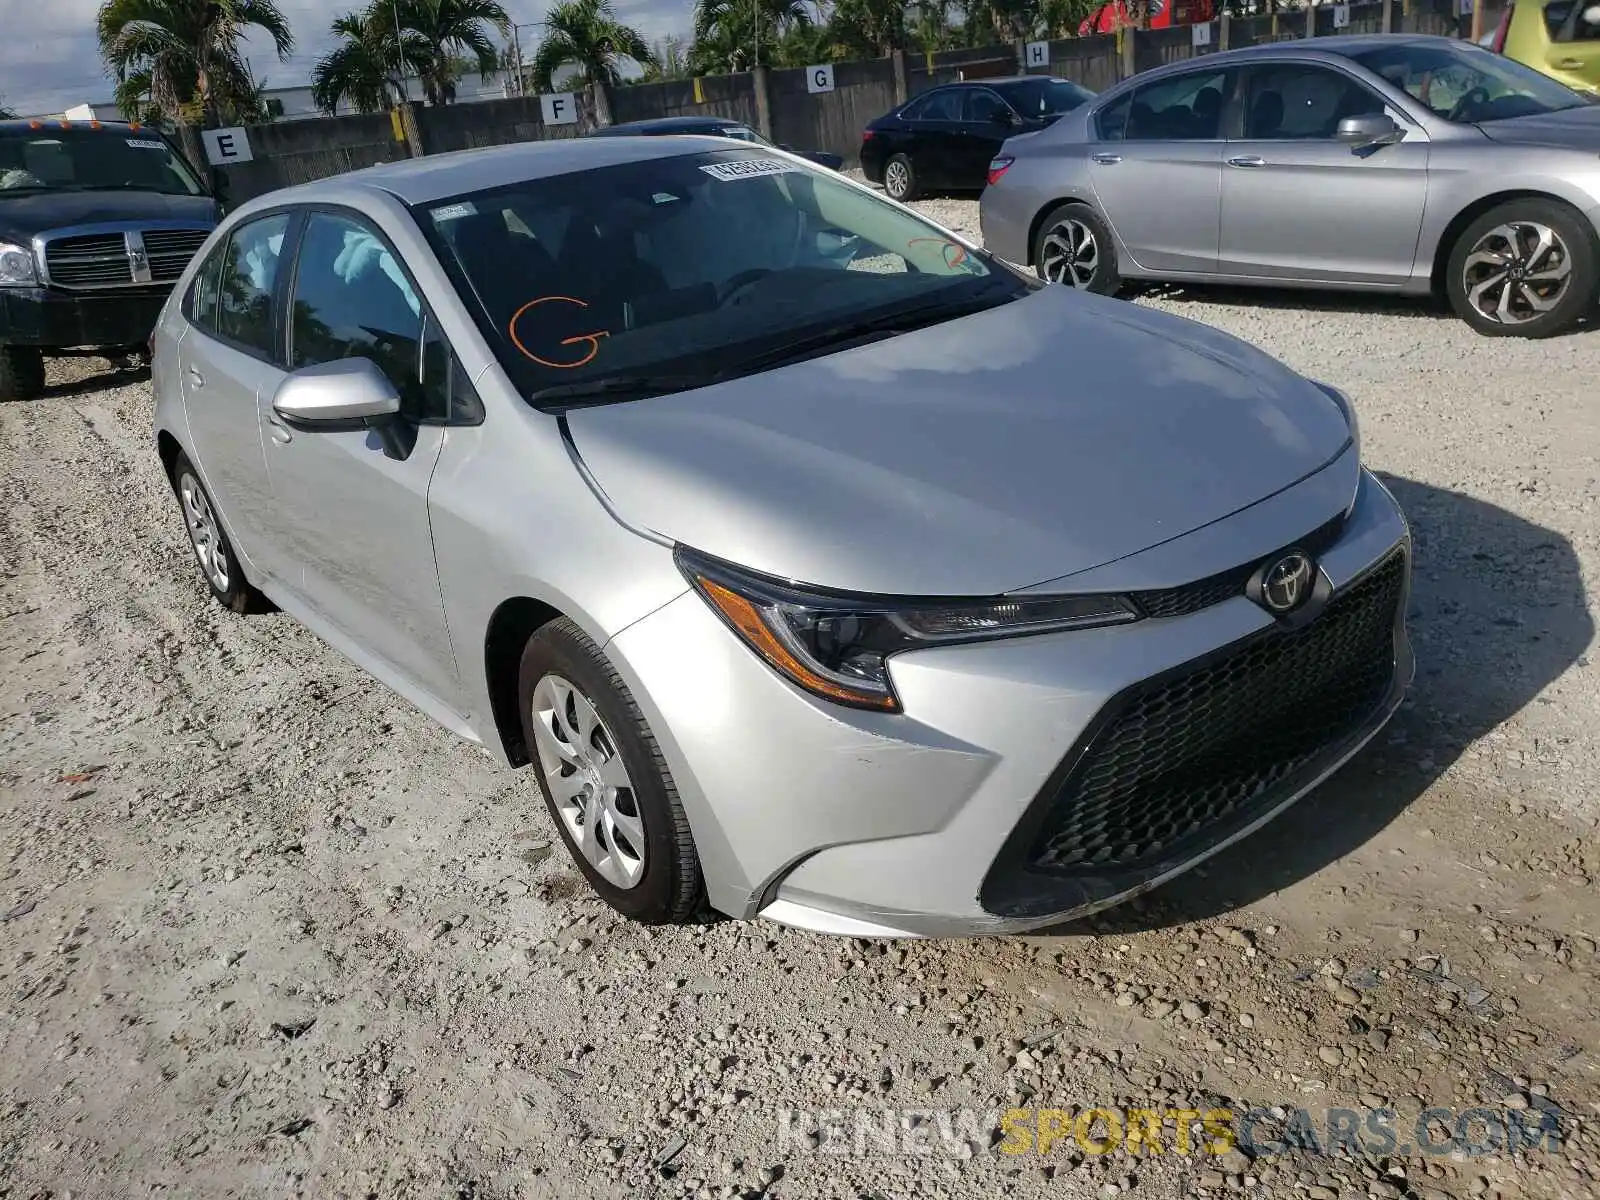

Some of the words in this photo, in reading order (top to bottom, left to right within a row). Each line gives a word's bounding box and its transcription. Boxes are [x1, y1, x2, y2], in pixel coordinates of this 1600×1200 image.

[1033, 47, 1042, 62] H
[815, 70, 827, 87] G
[552, 99, 564, 119] F
[216, 134, 238, 157] E
[509, 296, 610, 368] G
